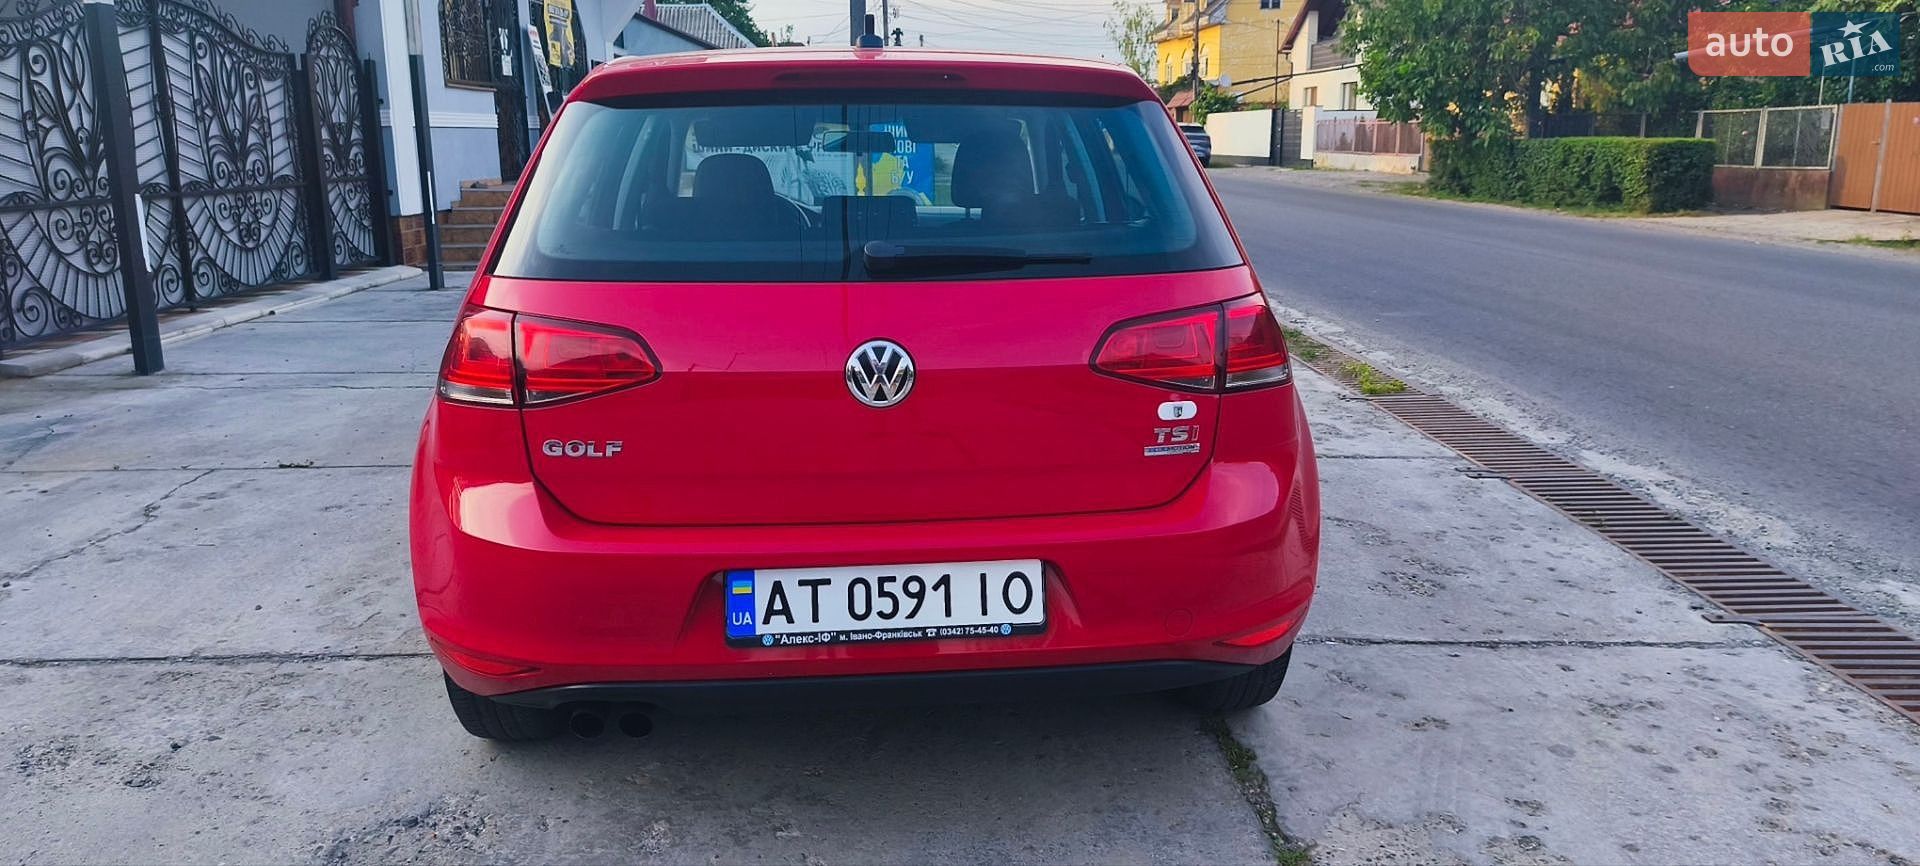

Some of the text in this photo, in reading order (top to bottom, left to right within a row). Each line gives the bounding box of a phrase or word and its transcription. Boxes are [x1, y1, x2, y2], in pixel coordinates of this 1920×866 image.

[894, 139, 916, 154] ОВІ
[1153, 425, 1200, 443] TSI
[542, 439, 624, 457] GOLF
[762, 577, 832, 625] AT
[847, 573, 952, 622] 0591
[732, 612, 753, 627] UA
[965, 625, 999, 635] 75-45-40
